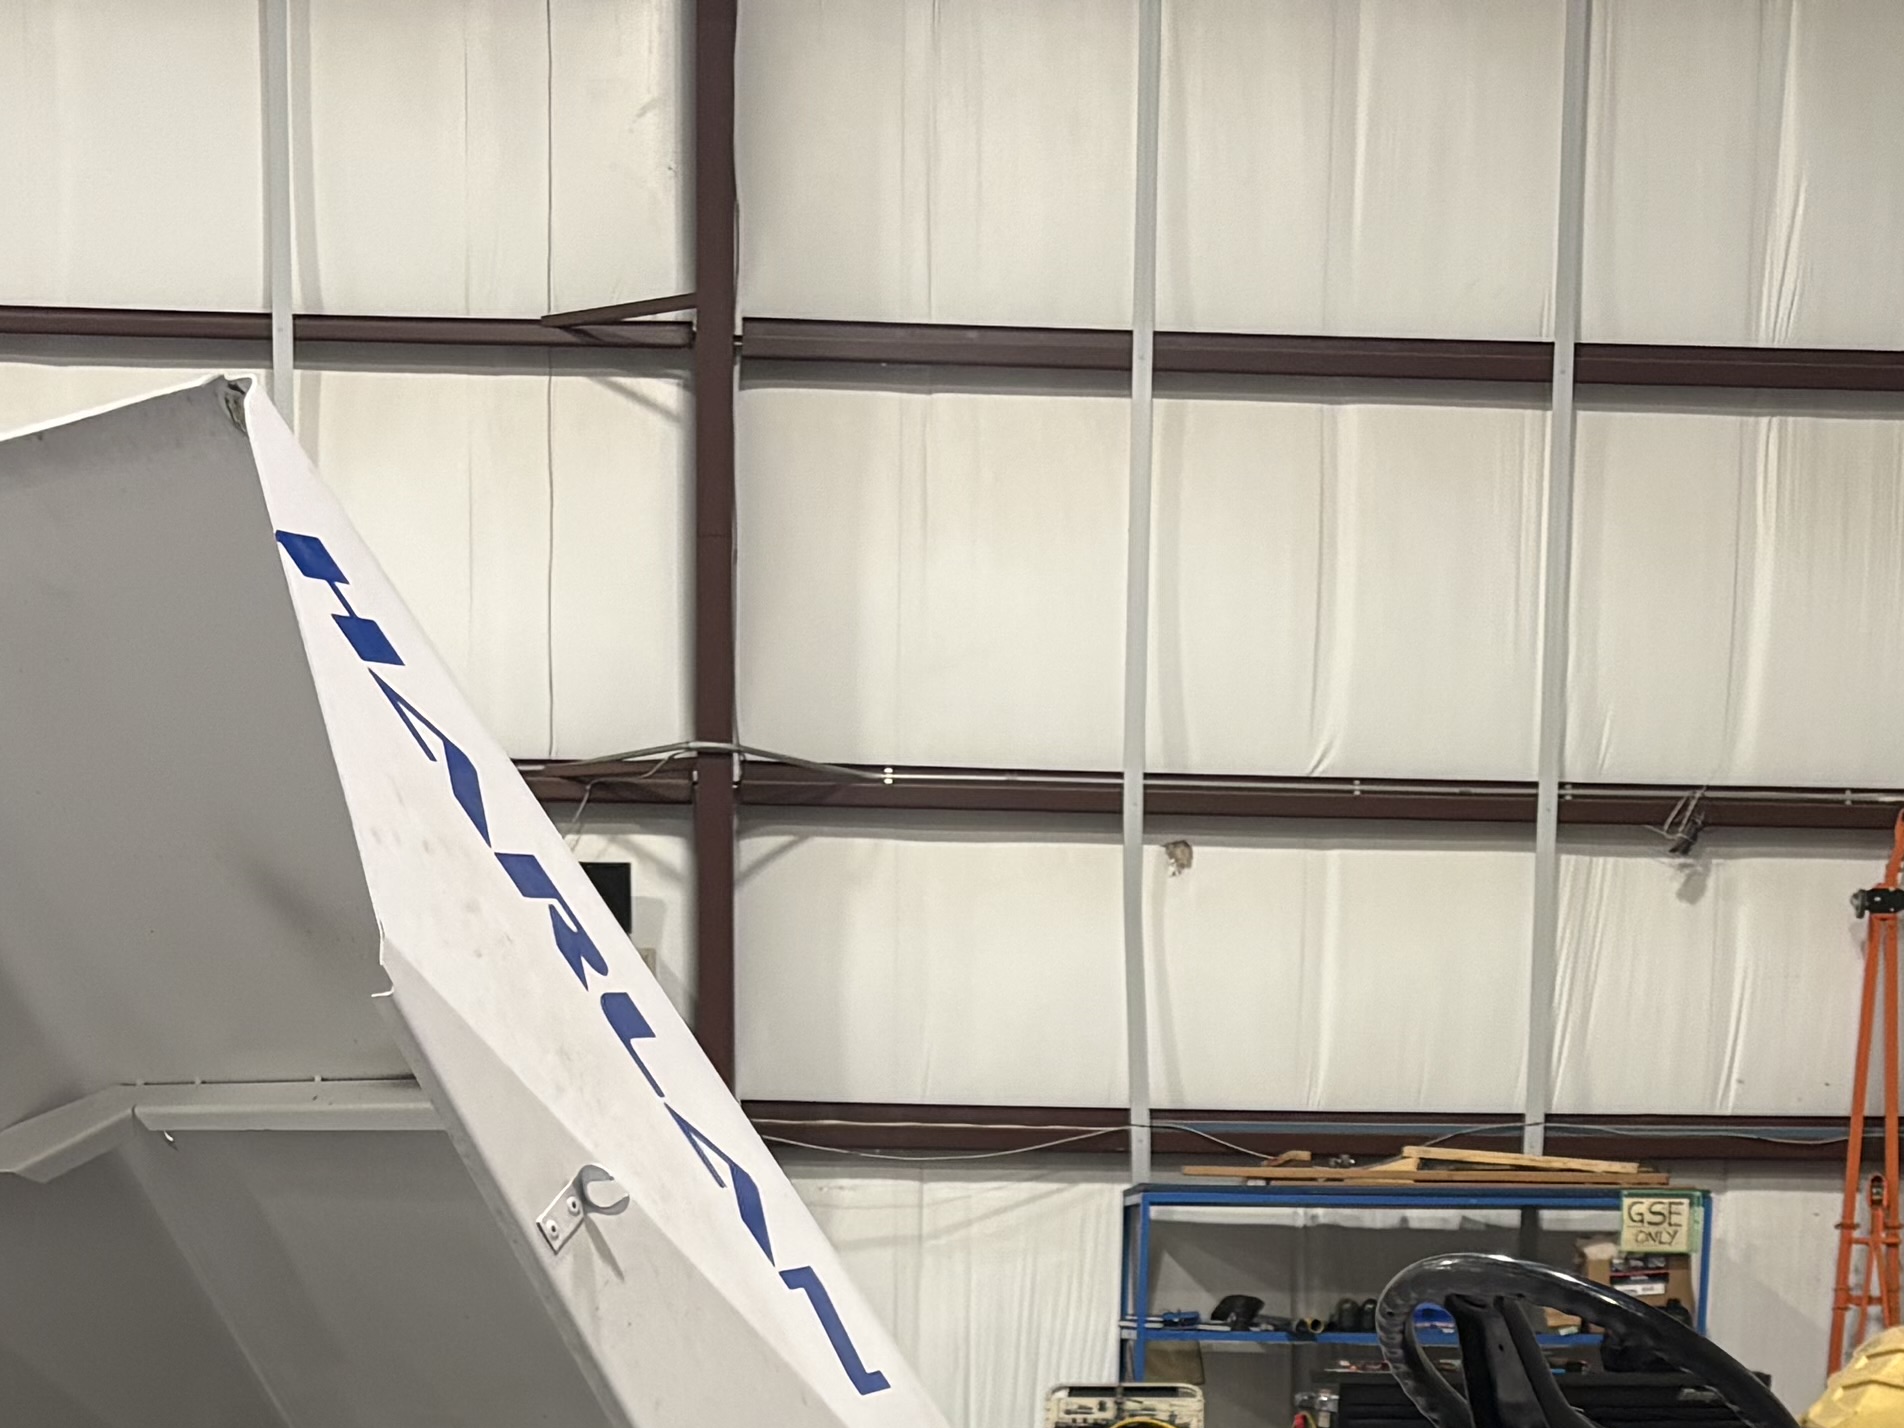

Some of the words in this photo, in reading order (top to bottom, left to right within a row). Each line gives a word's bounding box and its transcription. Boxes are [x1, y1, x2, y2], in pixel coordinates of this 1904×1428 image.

[276, 530, 890, 1396] HARLAN
[1627, 1201, 1684, 1227] GSE
[1636, 1229, 1678, 1246] ONLY
